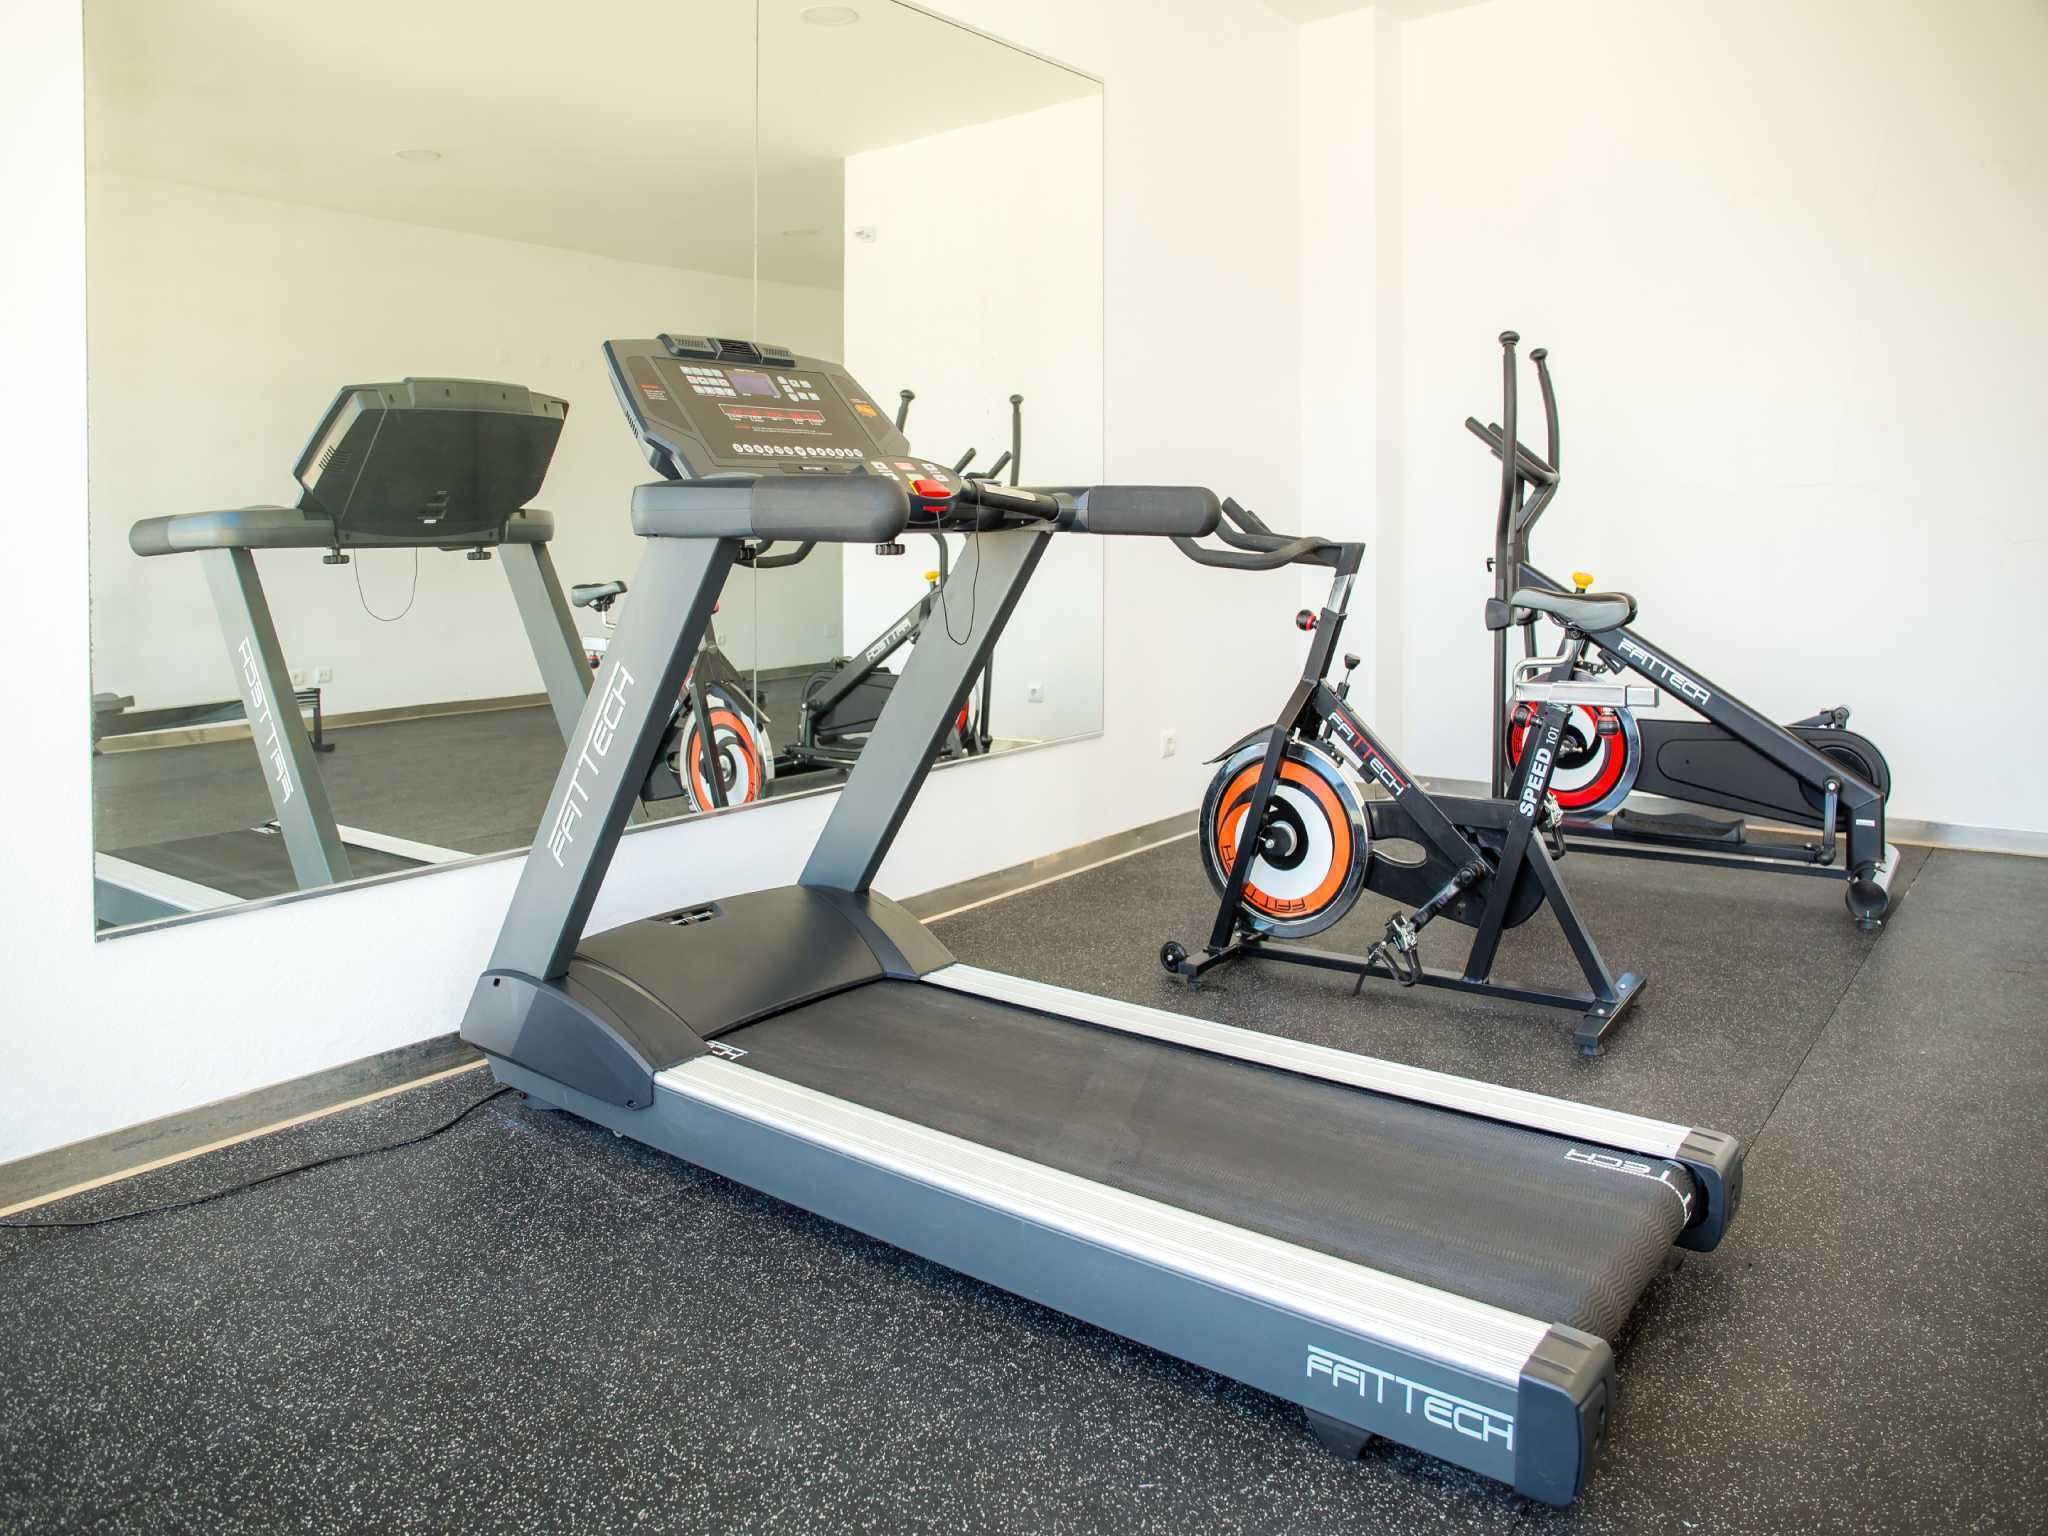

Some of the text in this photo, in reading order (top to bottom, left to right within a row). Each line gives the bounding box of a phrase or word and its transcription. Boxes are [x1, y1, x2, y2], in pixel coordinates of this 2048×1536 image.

[1519, 726, 1560, 817] SPEED 101
[1306, 1344, 1515, 1451] FFITTECH
